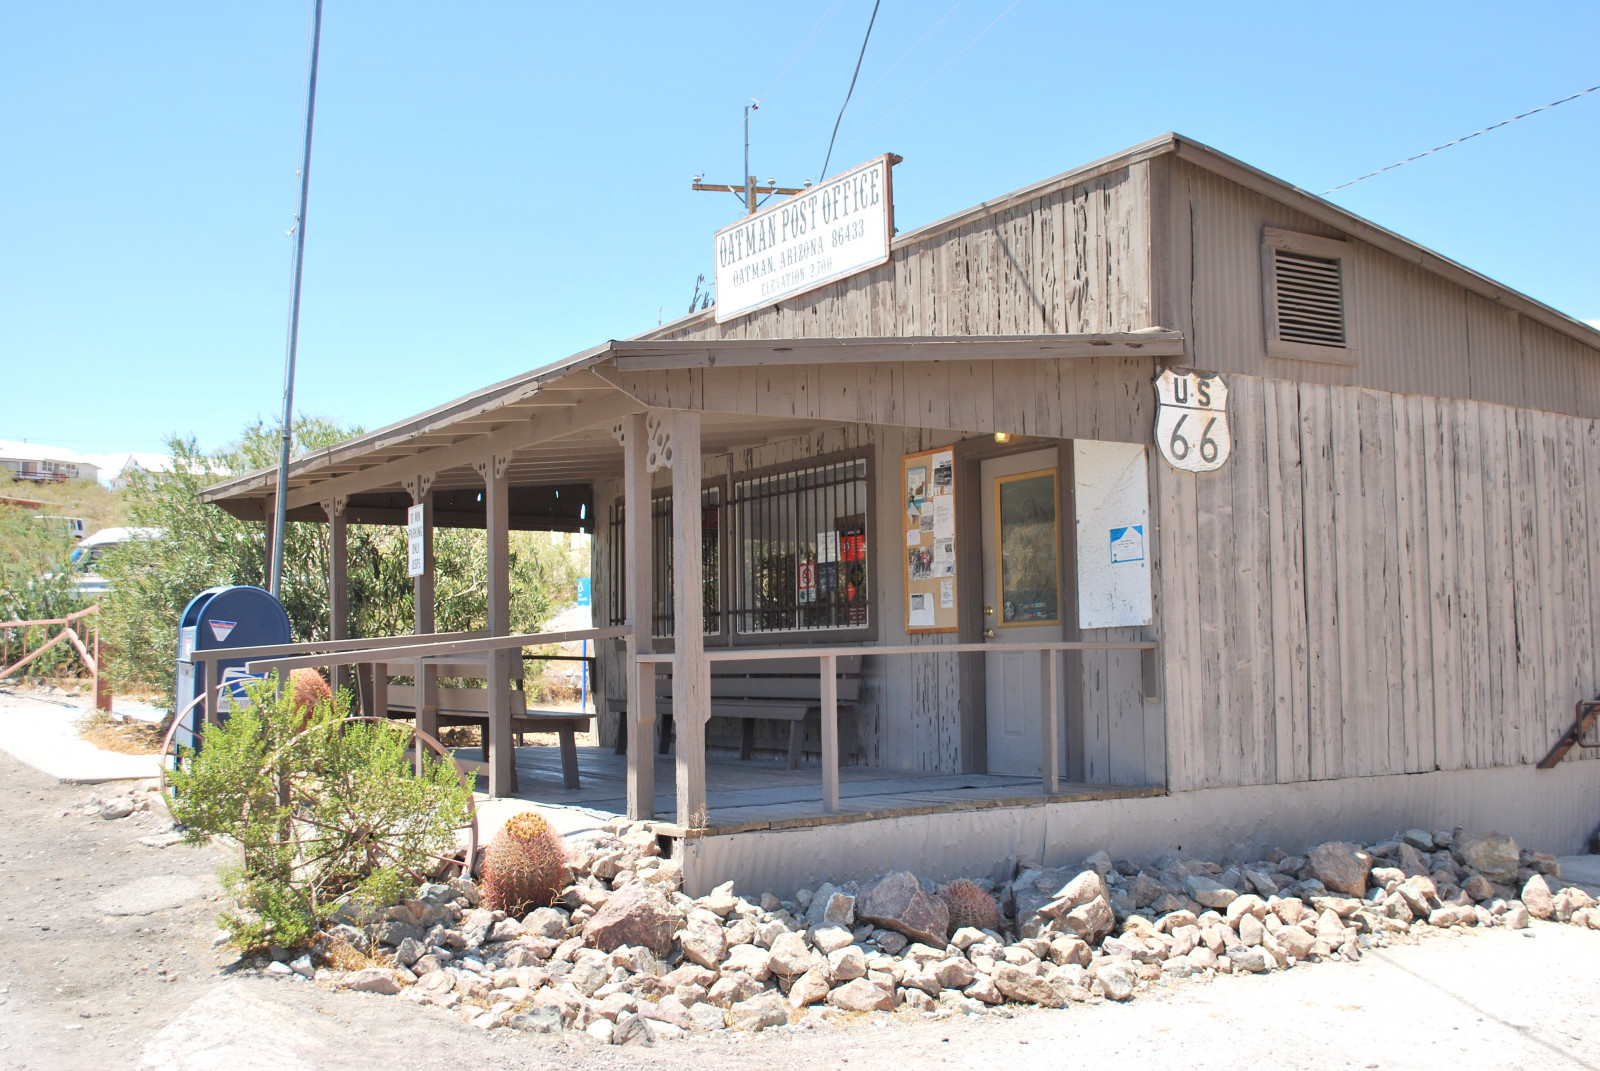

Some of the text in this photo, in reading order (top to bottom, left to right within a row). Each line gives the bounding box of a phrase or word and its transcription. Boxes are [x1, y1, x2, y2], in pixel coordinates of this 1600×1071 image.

[720, 168, 879, 268] OATMAN POST OFFICE
[733, 218, 864, 287] OATMAN, ARIZONA 86433
[761, 268, 805, 297] ELEVATION
[1170, 414, 1218, 463] 66
